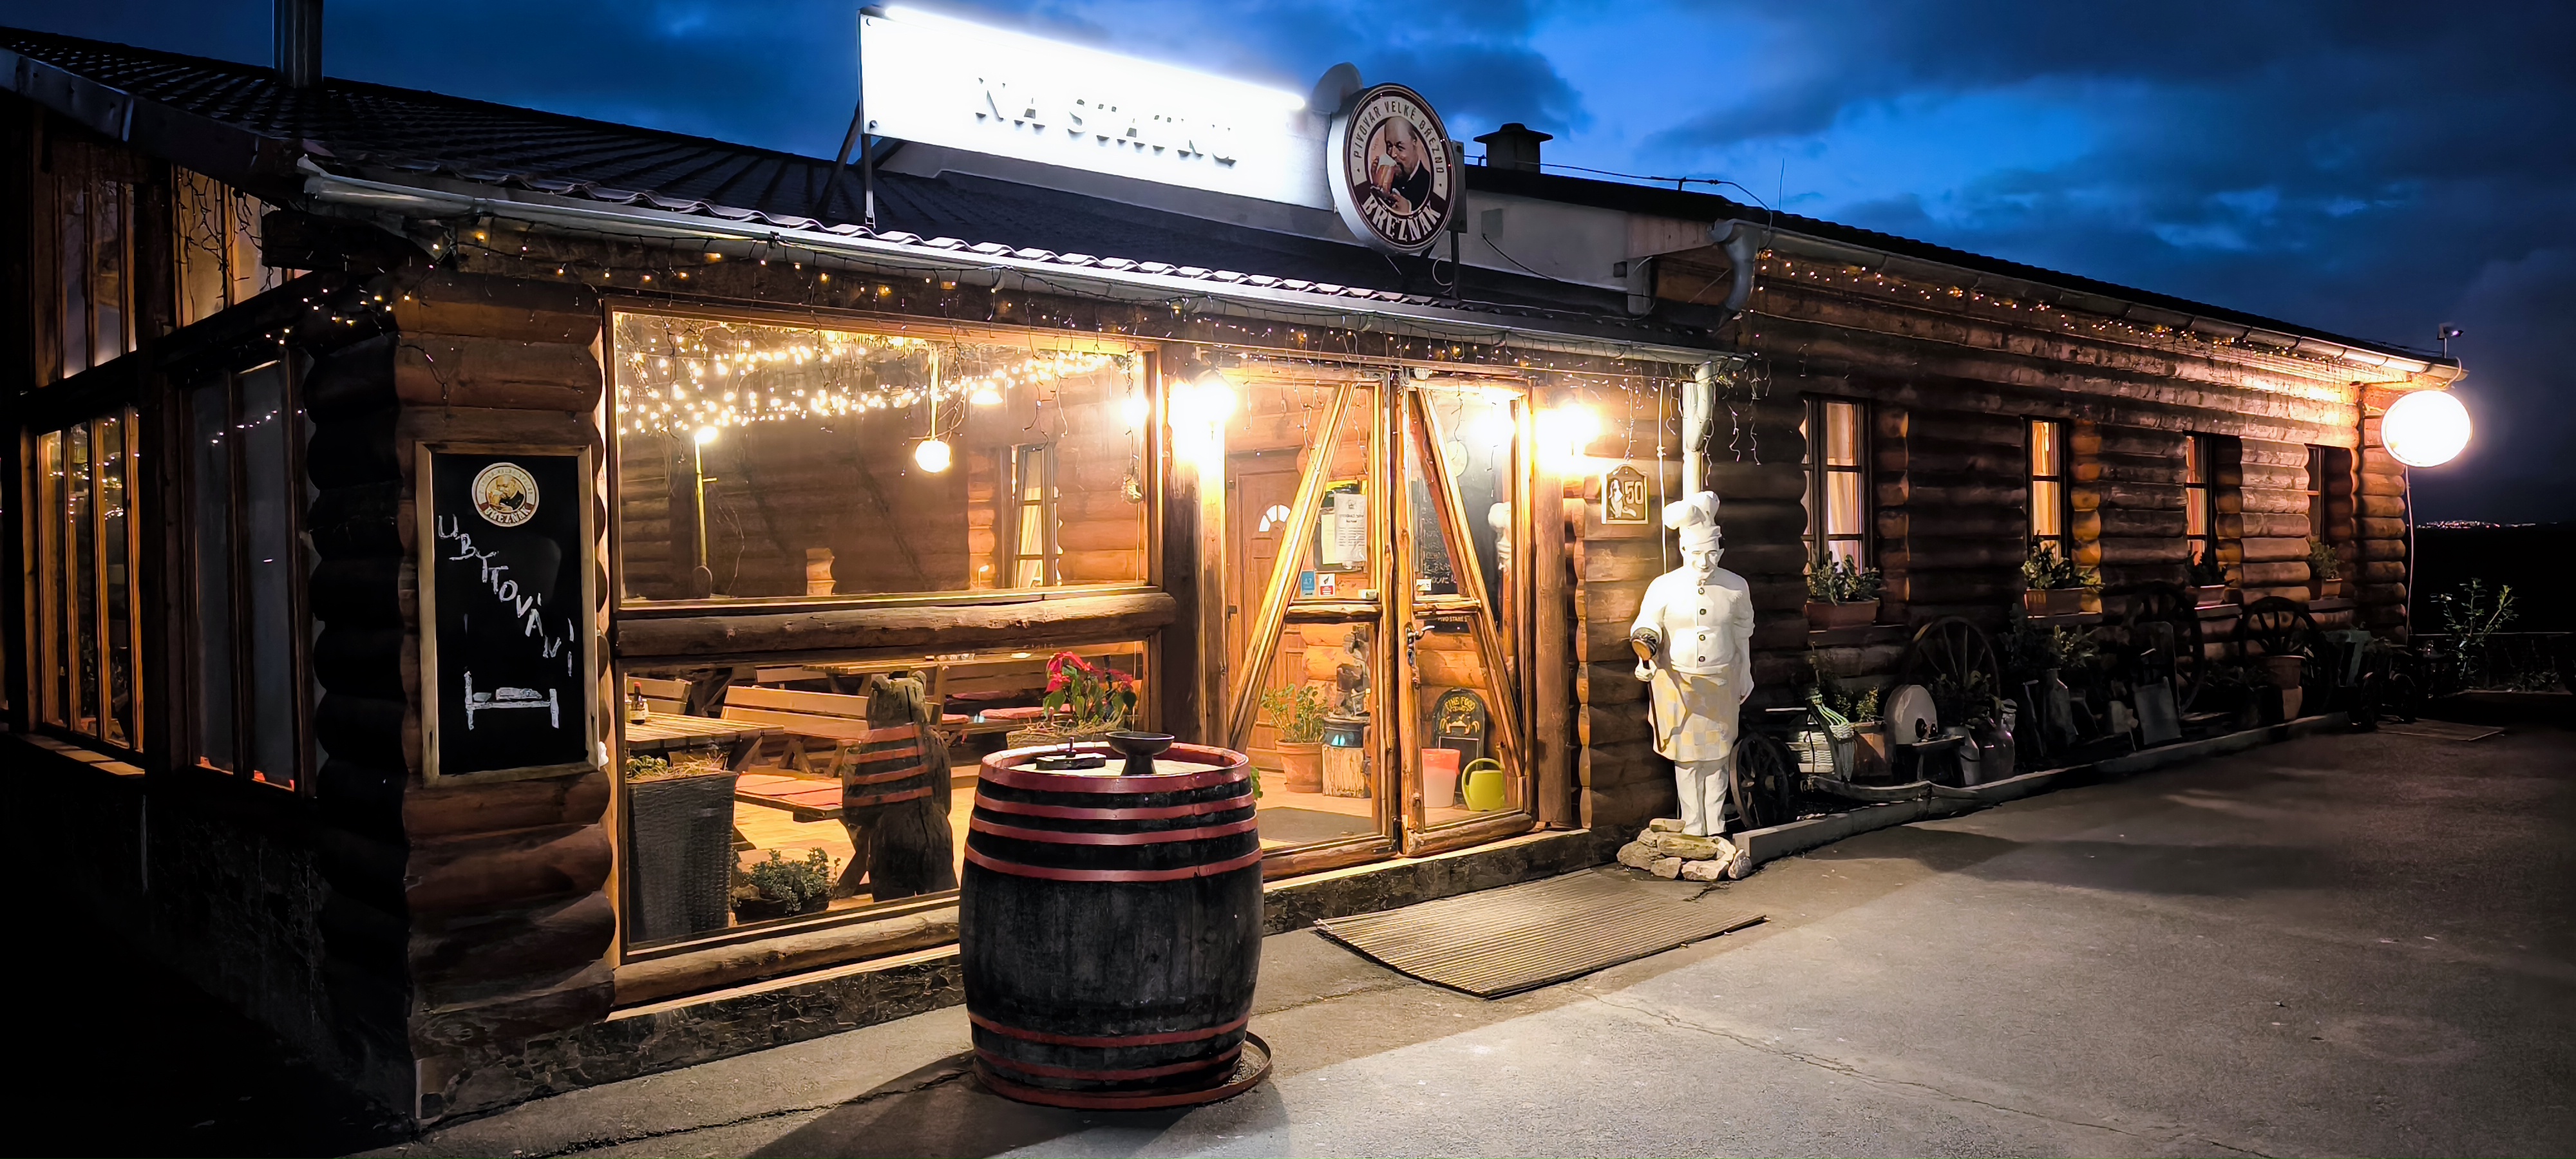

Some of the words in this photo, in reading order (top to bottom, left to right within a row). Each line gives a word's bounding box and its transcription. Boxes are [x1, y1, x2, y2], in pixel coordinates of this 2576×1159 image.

[1353, 106, 1382, 159] PIVOVAR
[1384, 100, 1417, 121] VELKÉ
[1624, 481, 1644, 505] 50
[1461, 696, 1476, 710] FOOD
